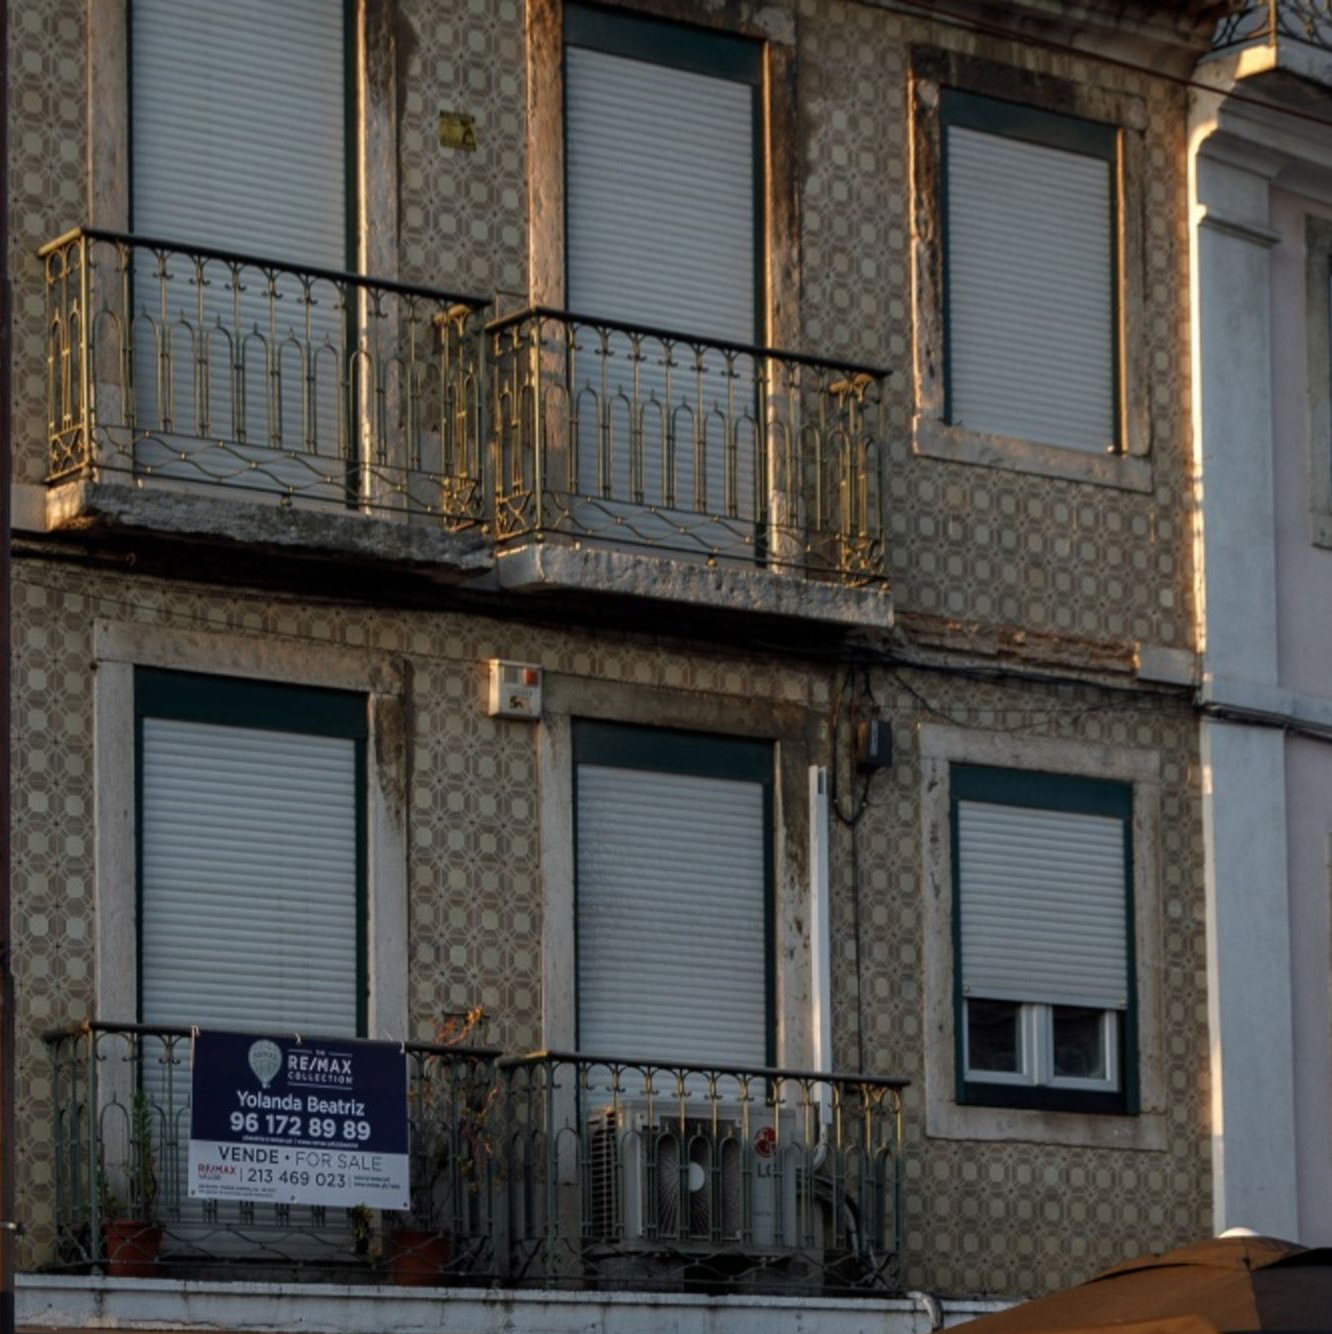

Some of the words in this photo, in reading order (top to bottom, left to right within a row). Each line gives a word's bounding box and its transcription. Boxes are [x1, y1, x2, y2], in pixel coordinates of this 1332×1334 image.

[287, 1054, 352, 1075] RE/MAX
[287, 1071, 353, 1085] COLLECTION
[236, 1090, 302, 1113] Yolanda
[307, 1095, 365, 1117] Beatriz
[230, 1111, 259, 1133] 96
[265, 1114, 302, 1136] 172
[308, 1117, 336, 1139] 89
[343, 1120, 371, 1141] 89
[218, 1146, 279, 1164] VENDE
[296, 1151, 333, 1168] FOR
[338, 1154, 383, 1172] SALE
[247, 1167, 273, 1183] 213
[279, 1170, 309, 1185] 469
[316, 1173, 345, 1188] 023
